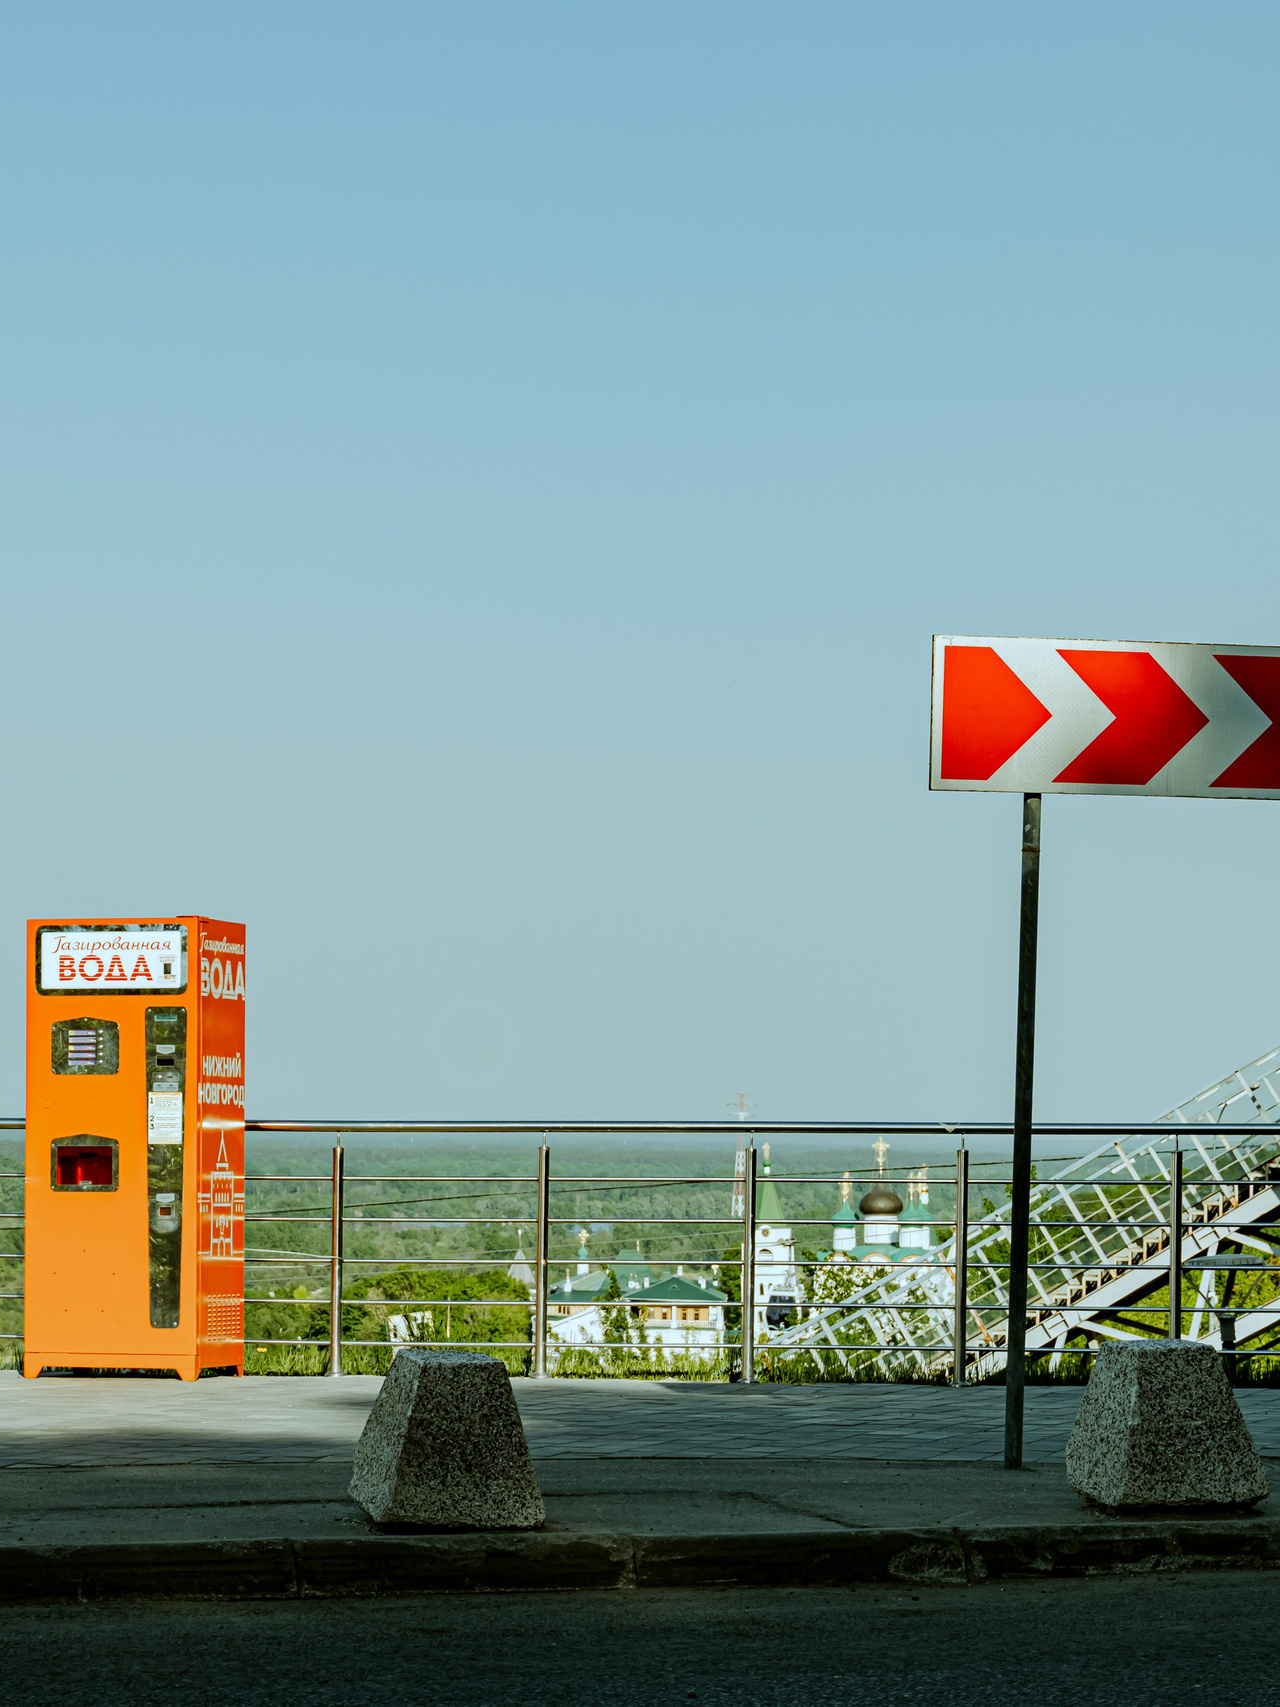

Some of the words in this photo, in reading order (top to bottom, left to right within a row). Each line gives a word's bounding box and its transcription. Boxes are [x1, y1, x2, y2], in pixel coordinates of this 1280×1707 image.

[52, 936, 171, 954] Газированная
[199, 932, 244, 956] Газированная
[59, 955, 153, 981] ВОДА
[201, 957, 245, 1001] ВОДА
[202, 1052, 241, 1078] НИЖНИЙ
[198, 1082, 245, 1109] НОВГОРОД
